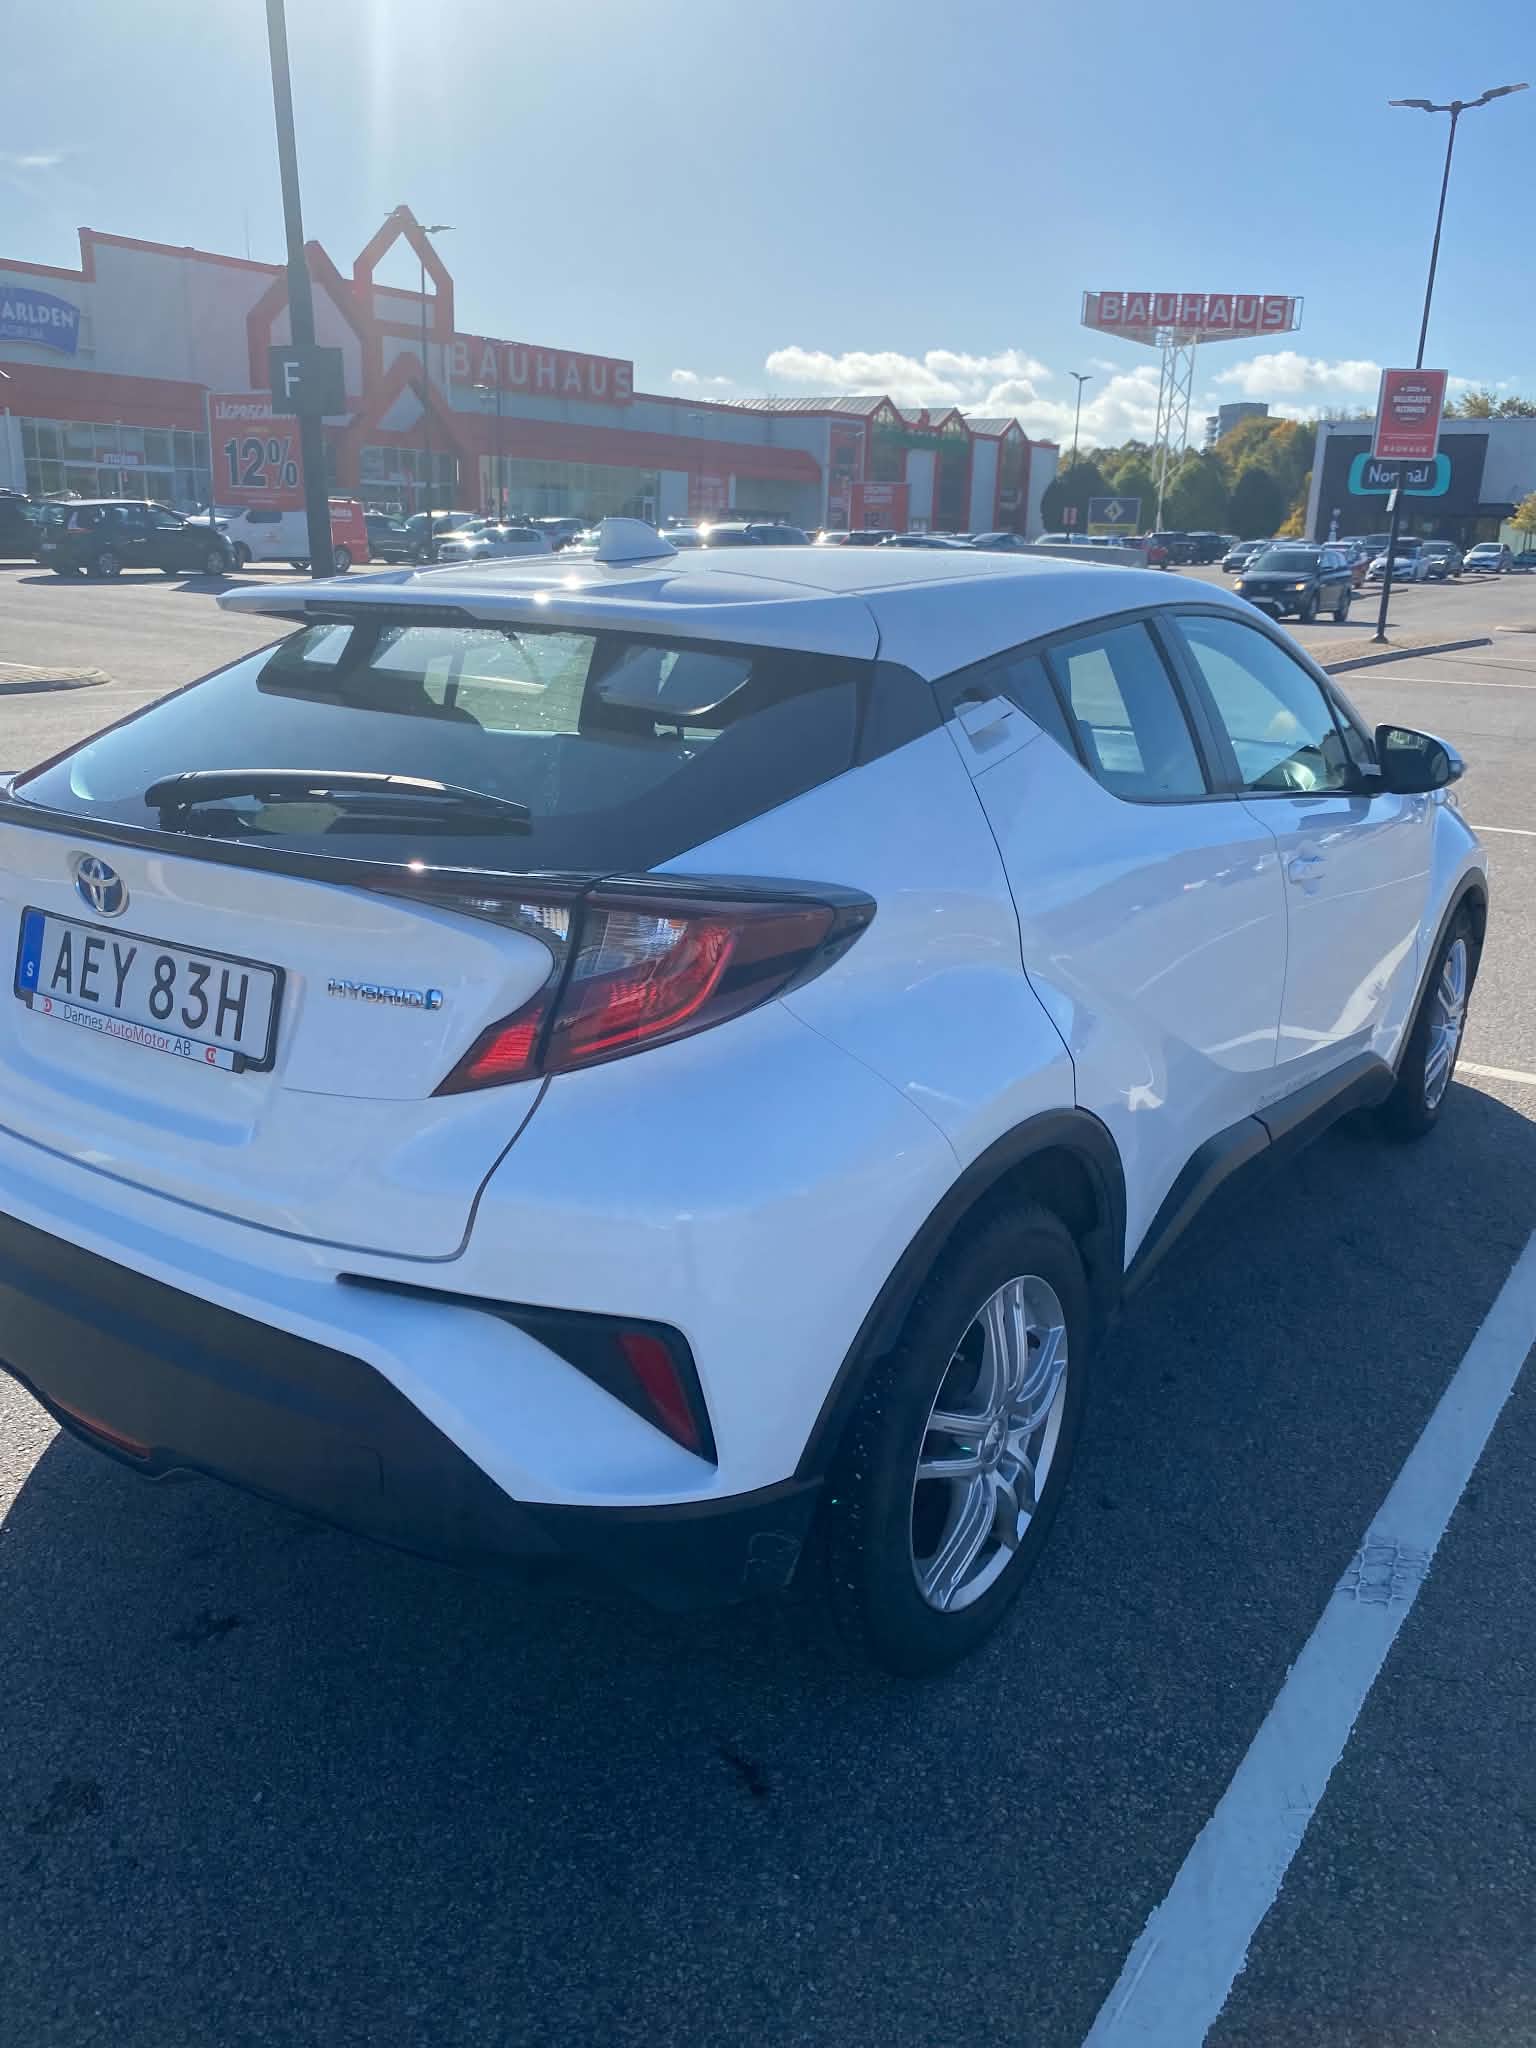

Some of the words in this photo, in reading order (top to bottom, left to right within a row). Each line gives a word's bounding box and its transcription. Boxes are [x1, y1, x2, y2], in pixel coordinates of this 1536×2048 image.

[1102, 296, 1284, 324] BAUHAUS
[283, 361, 300, 398] F
[450, 341, 632, 398] BAUHAUS
[224, 435, 298, 489] 12%
[26, 961, 34, 977] S
[51, 931, 137, 1009] AEY
[150, 955, 249, 1042] 83H
[328, 978, 424, 1008] HYBRID
[64, 1004, 104, 1030] Dannes
[105, 1015, 170, 1050] AutoMotor
[174, 1038, 192, 1056] AB
